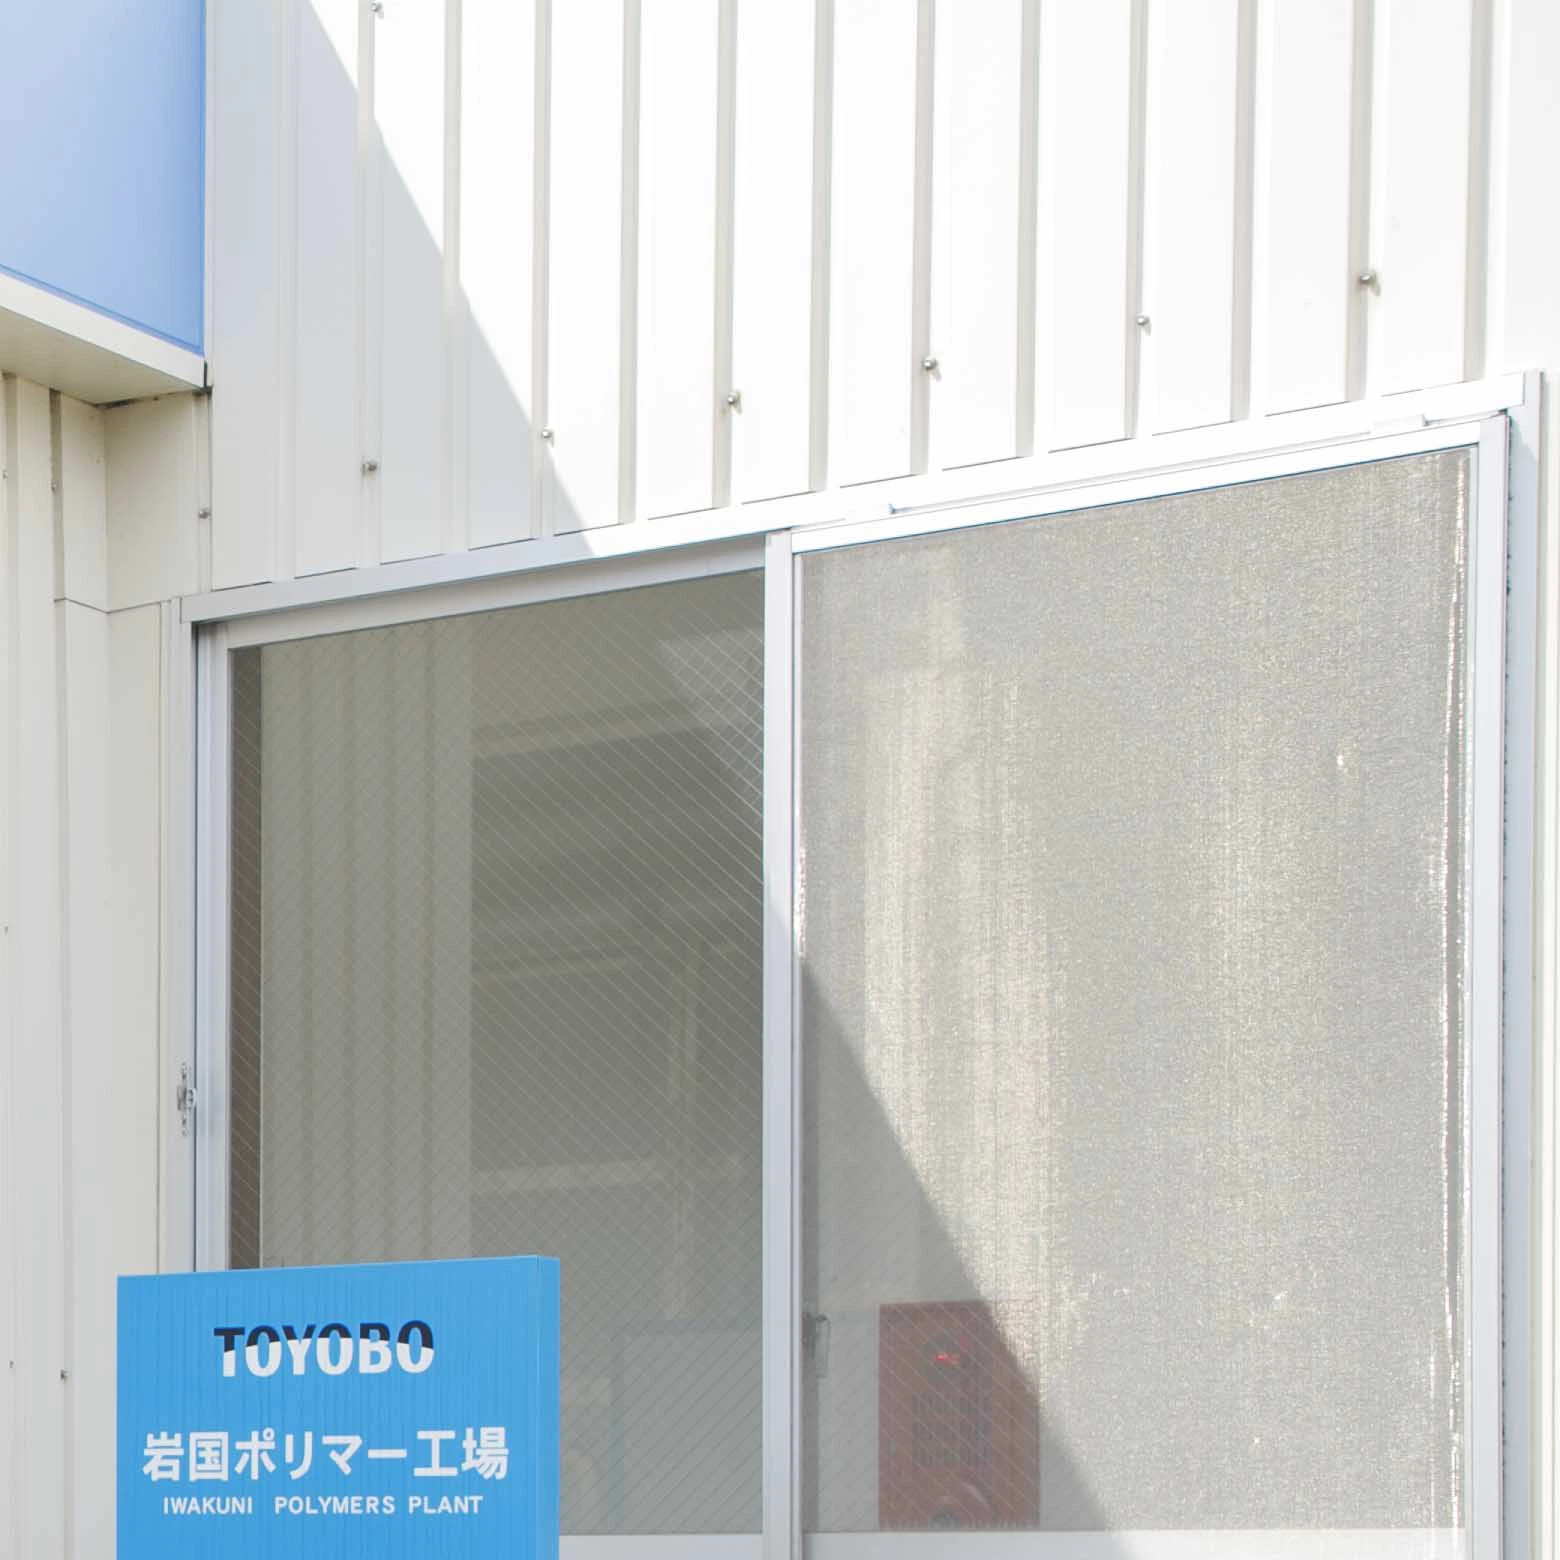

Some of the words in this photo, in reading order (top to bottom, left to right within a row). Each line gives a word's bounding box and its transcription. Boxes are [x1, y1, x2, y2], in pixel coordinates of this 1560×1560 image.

[213, 1320, 435, 1377] TOYOBO
[142, 1427, 509, 1482] 岩国ポリマー工場
[163, 1496, 253, 1515] IWAKUNI
[274, 1495, 395, 1515] POLYMERS
[408, 1495, 484, 1514] PLANT
